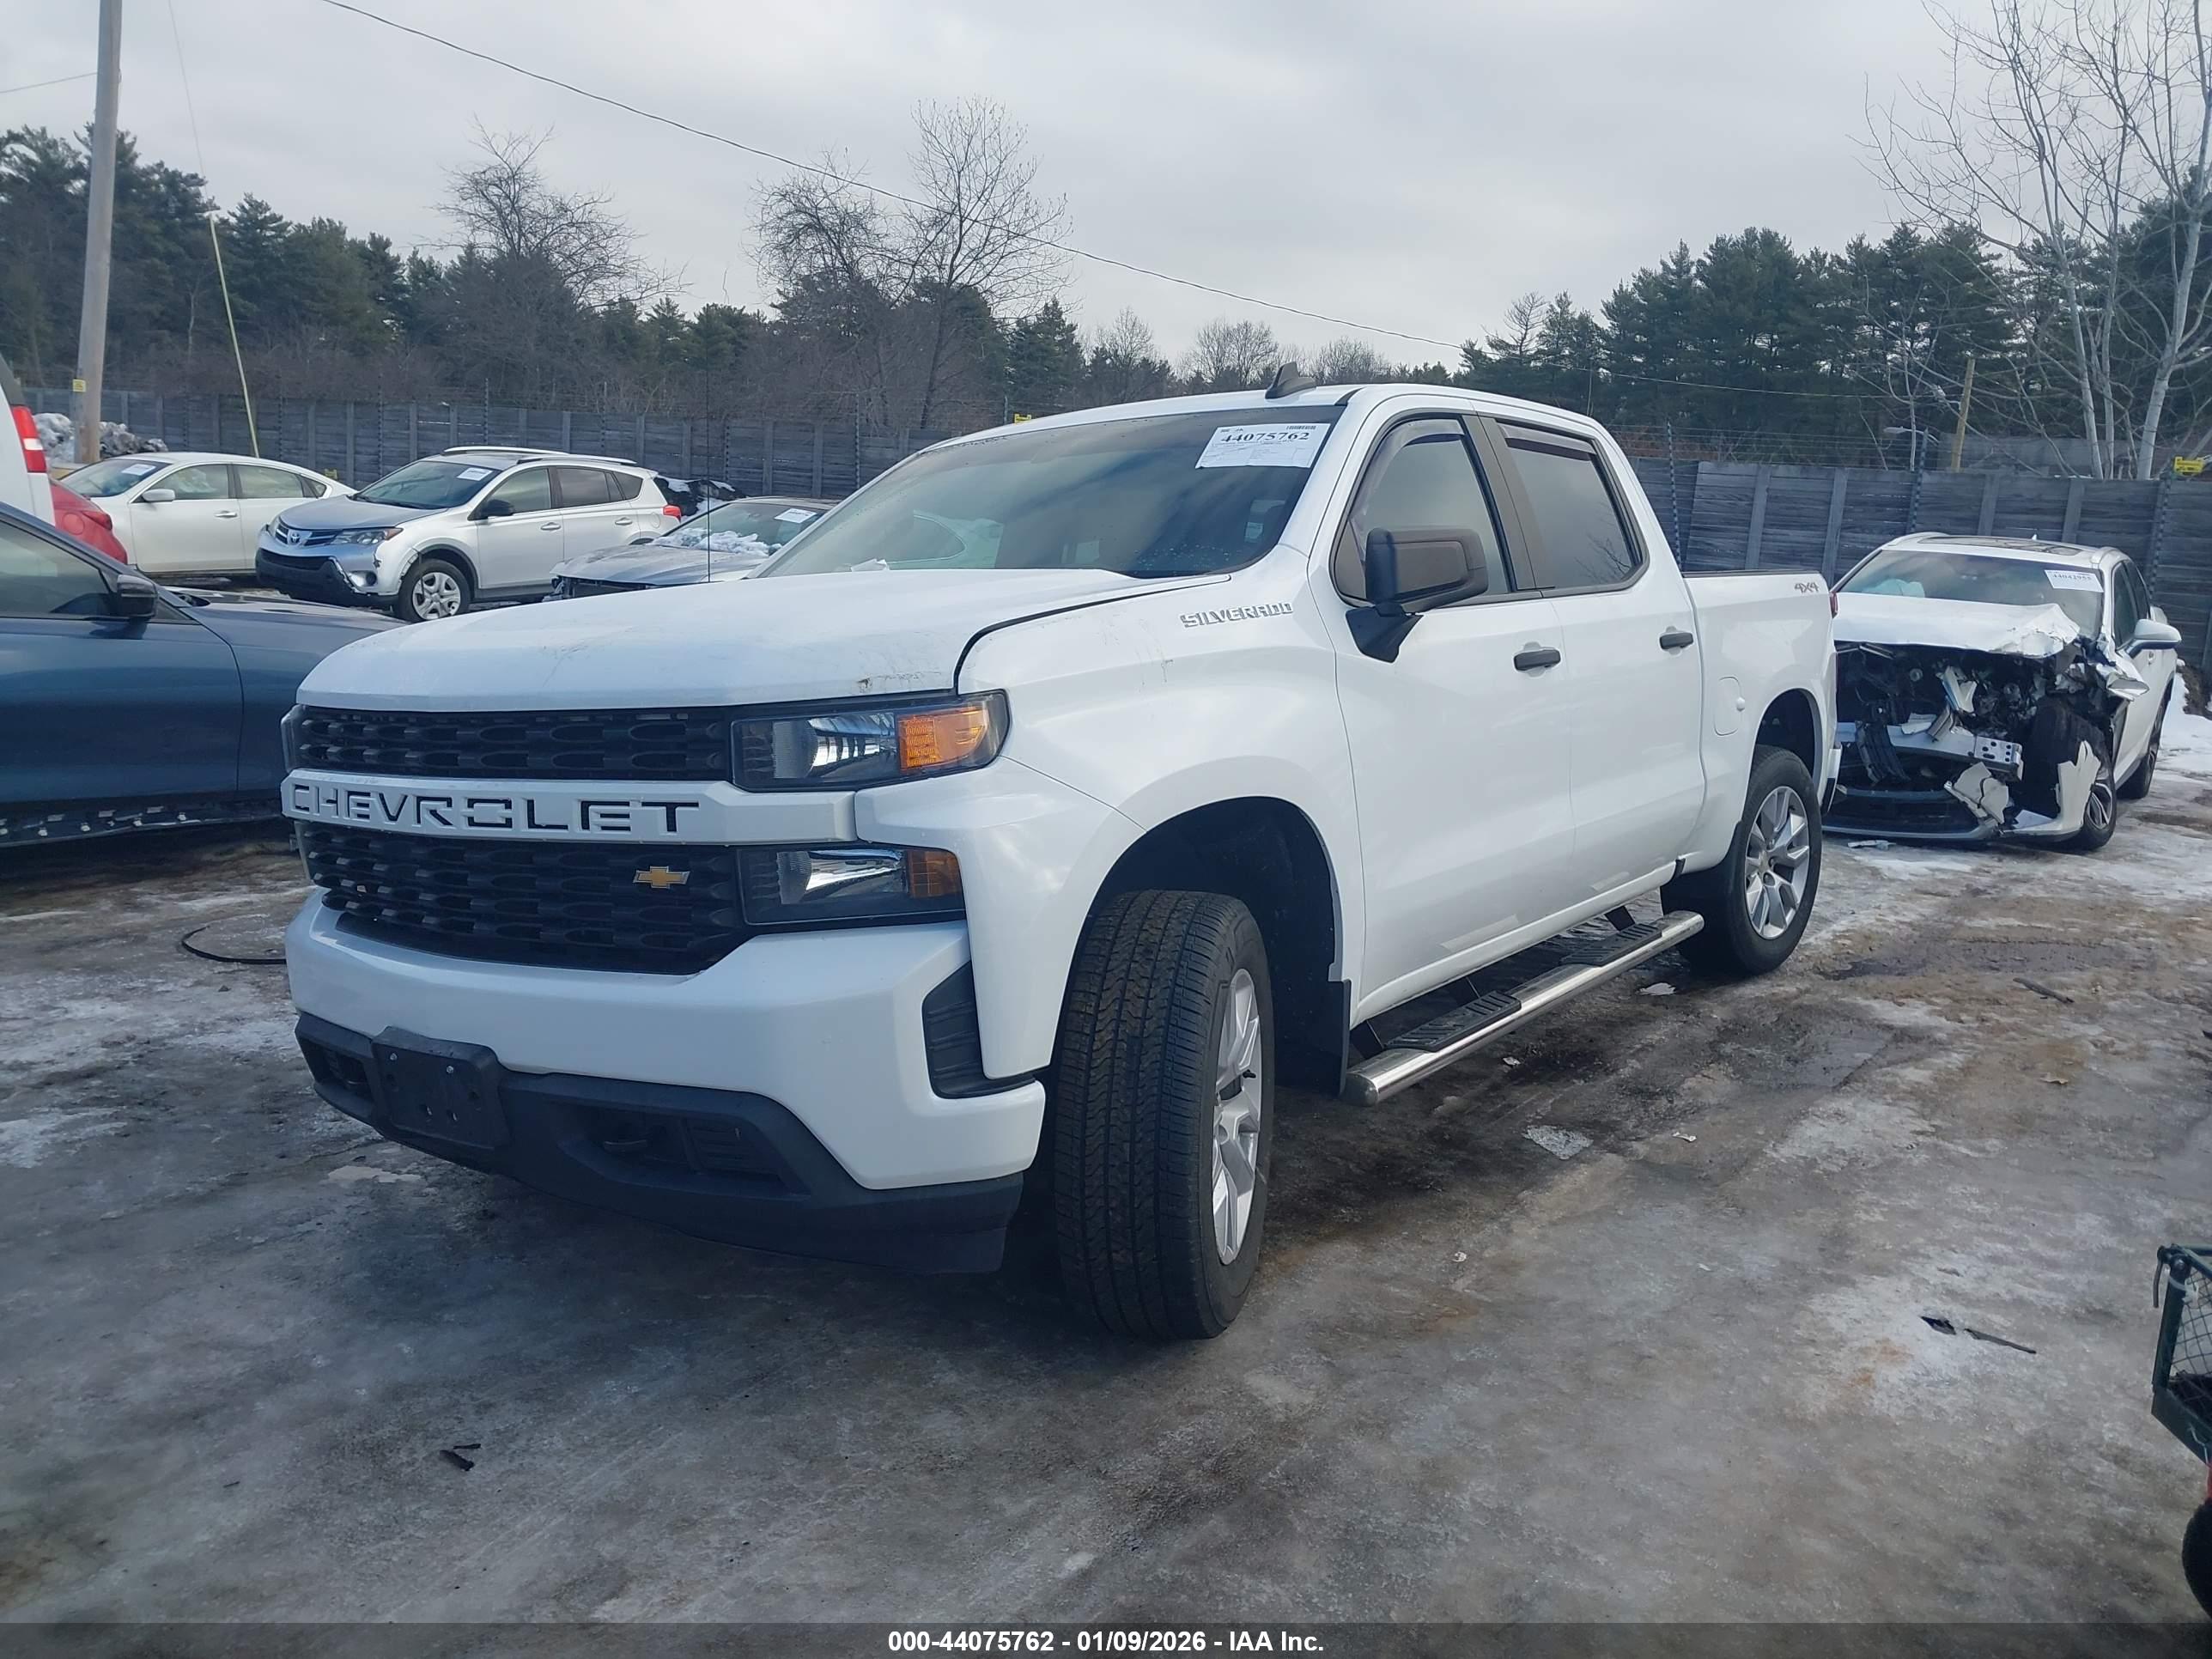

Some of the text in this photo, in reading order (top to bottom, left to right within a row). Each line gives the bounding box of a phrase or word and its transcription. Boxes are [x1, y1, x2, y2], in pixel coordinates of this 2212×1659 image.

[1220, 432, 1310, 443] 44075762
[1180, 602, 1294, 629] SILVERADO
[292, 784, 701, 834] CHEVROLET
